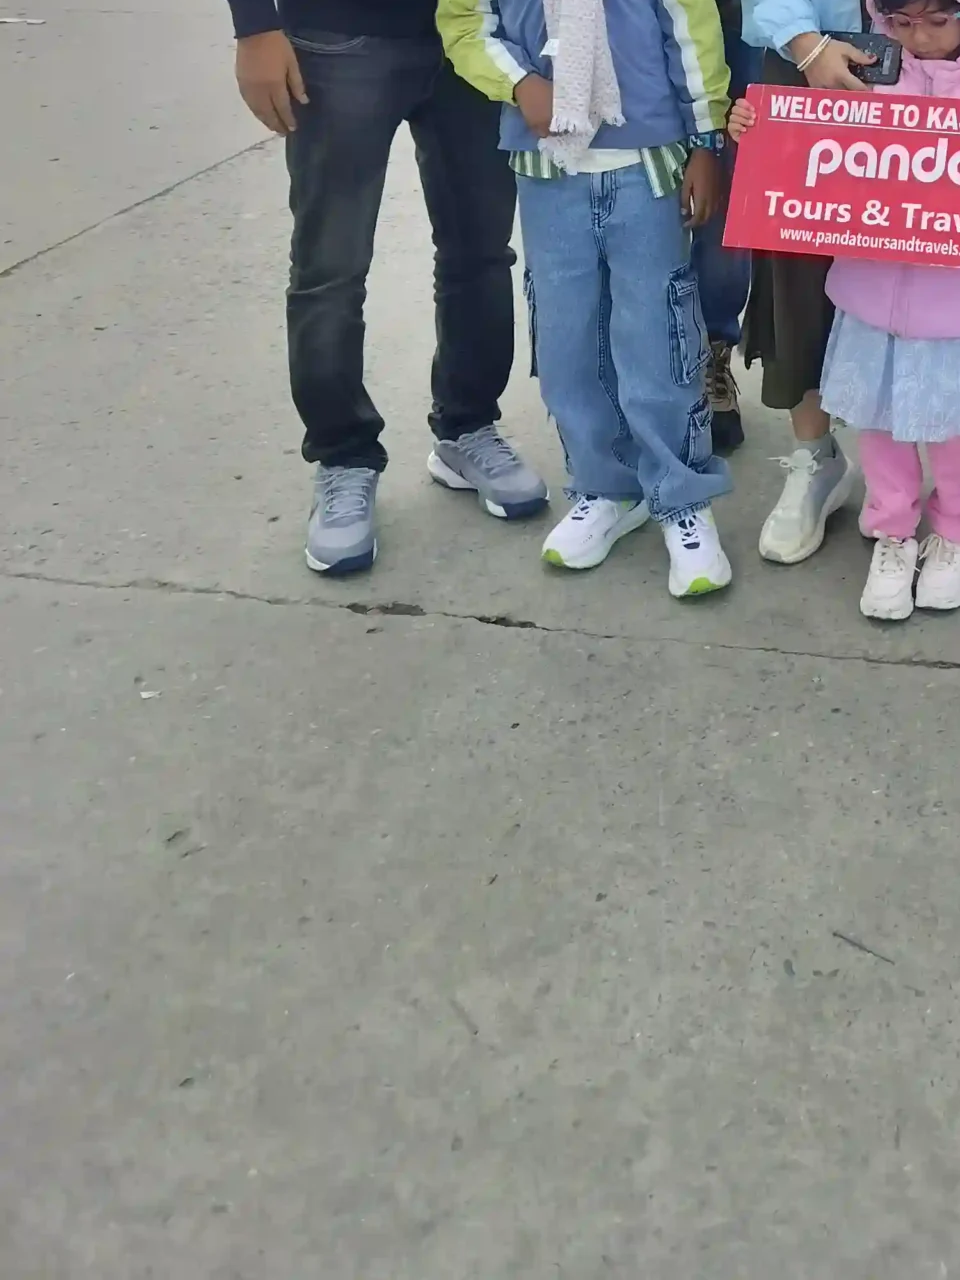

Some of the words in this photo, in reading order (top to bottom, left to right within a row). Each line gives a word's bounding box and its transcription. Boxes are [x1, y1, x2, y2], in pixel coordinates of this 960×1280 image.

[770, 94, 883, 124] WELCOME
[890, 103, 920, 128] TO
[764, 190, 852, 224] Tours
[860, 199, 891, 228] &
